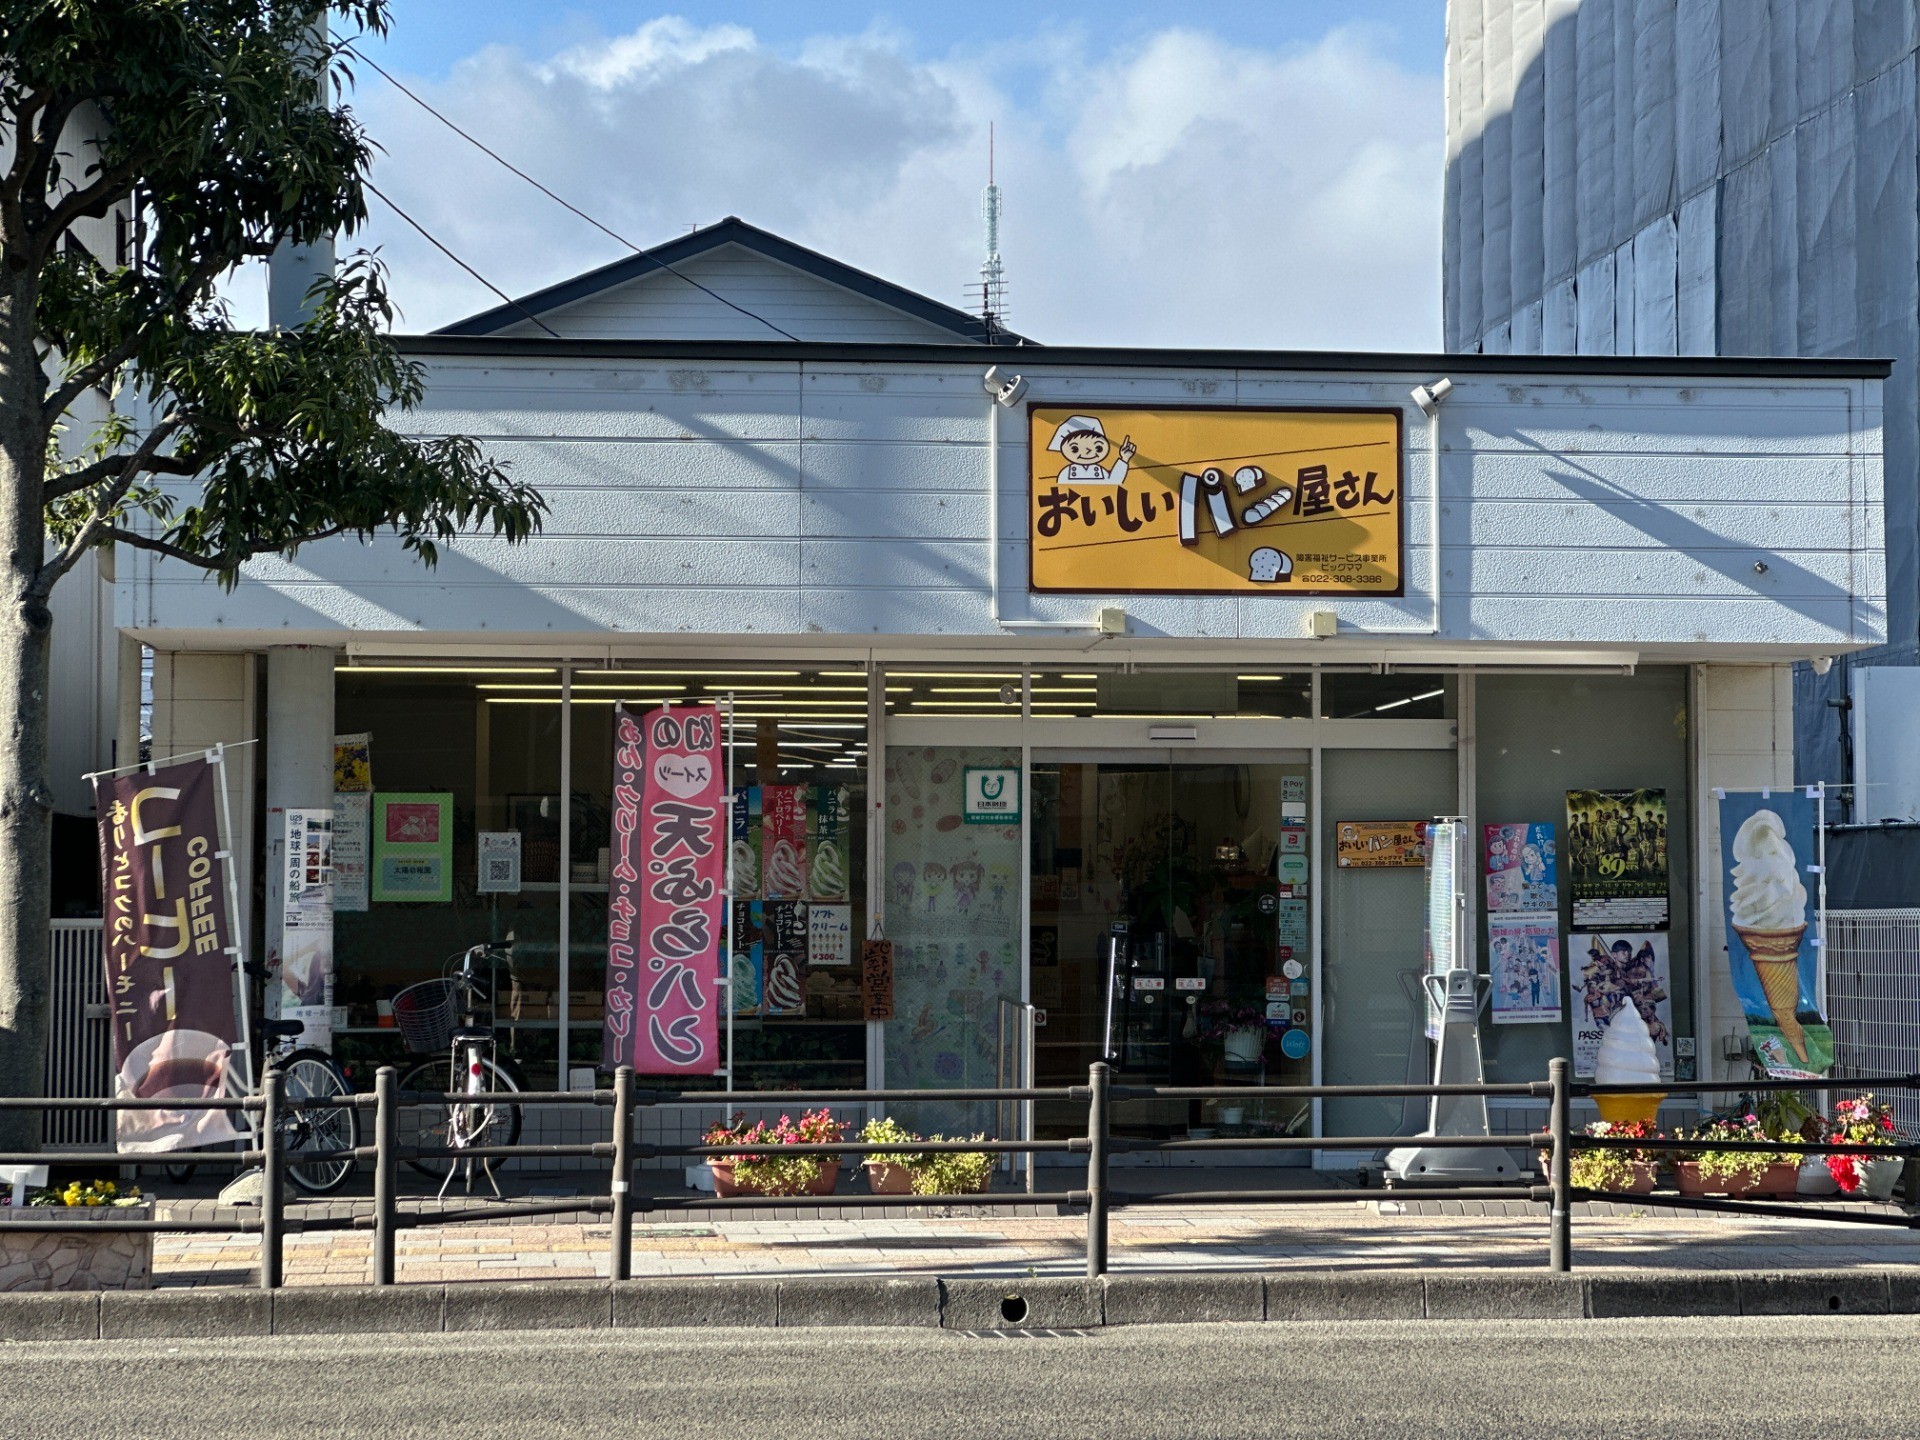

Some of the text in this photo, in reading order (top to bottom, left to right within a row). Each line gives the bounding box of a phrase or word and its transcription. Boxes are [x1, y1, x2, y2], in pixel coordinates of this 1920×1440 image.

[1037, 464, 1395, 547] おいしいパン屋さん
[1296, 552, 1388, 563] 障害福祉サービス事業所
[1320, 563, 1363, 572] ビッグママ
[1309, 574, 1383, 584] 022-308-3386
[732, 790, 748, 830] バニラ
[289, 814, 303, 822] U29
[818, 814, 829, 835] 抹茶
[1338, 834, 1416, 853] おいしいパン屋さん
[288, 828, 302, 903] 地球一周の船旅
[811, 909, 836, 919] ソフト
[736, 902, 746, 950] チョコミント
[775, 905, 785, 951] チョコレート
[811, 922, 849, 932] クリーム
[812, 953, 836, 961] ¥300
[866, 969, 892, 1020] 営業中
[1578, 1030, 1605, 1042] PASS
[1286, 1039, 1305, 1049] Wolt
